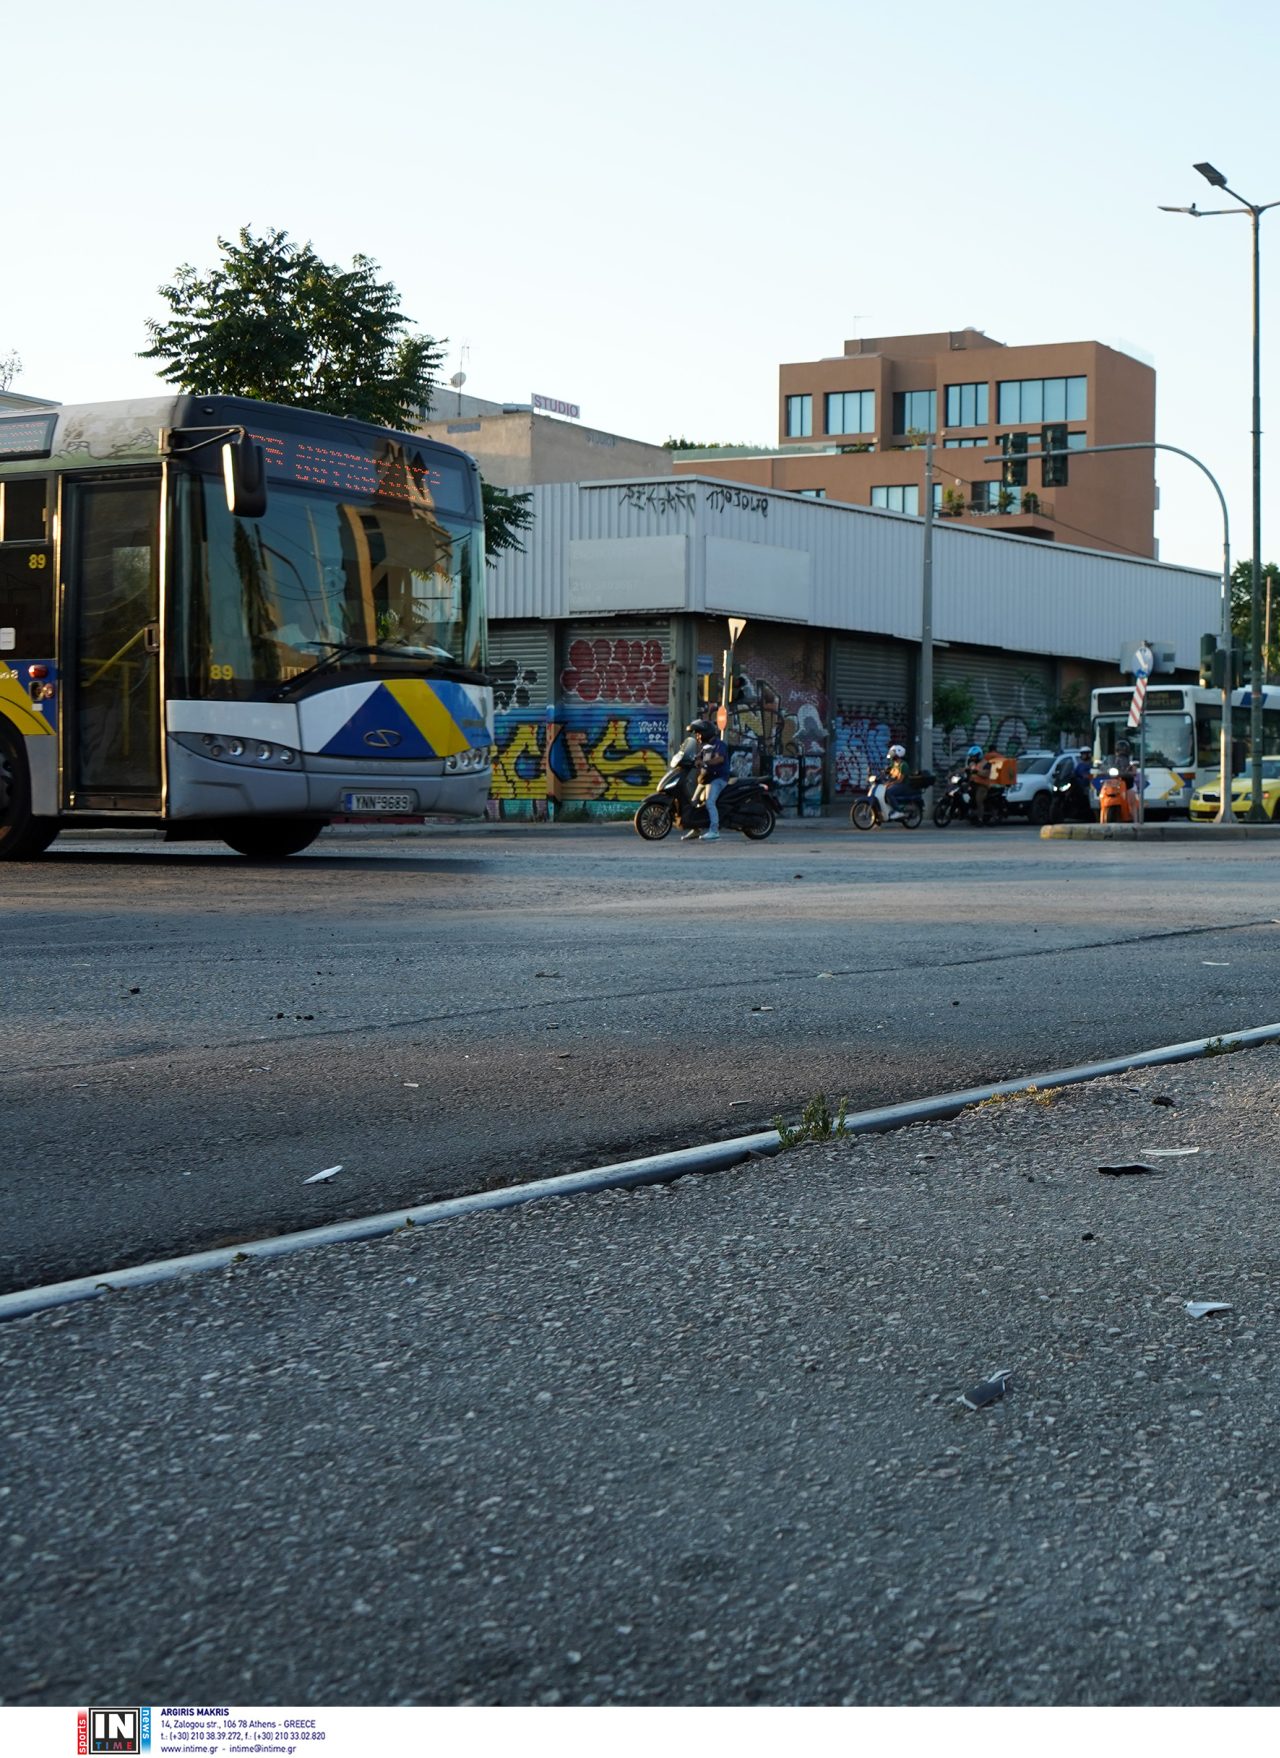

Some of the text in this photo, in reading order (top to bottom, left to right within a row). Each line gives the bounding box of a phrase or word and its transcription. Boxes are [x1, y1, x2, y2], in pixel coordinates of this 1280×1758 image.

[534, 394, 579, 417] STUDIO
[29, 553, 46, 569] 89
[210, 664, 233, 680] 89
